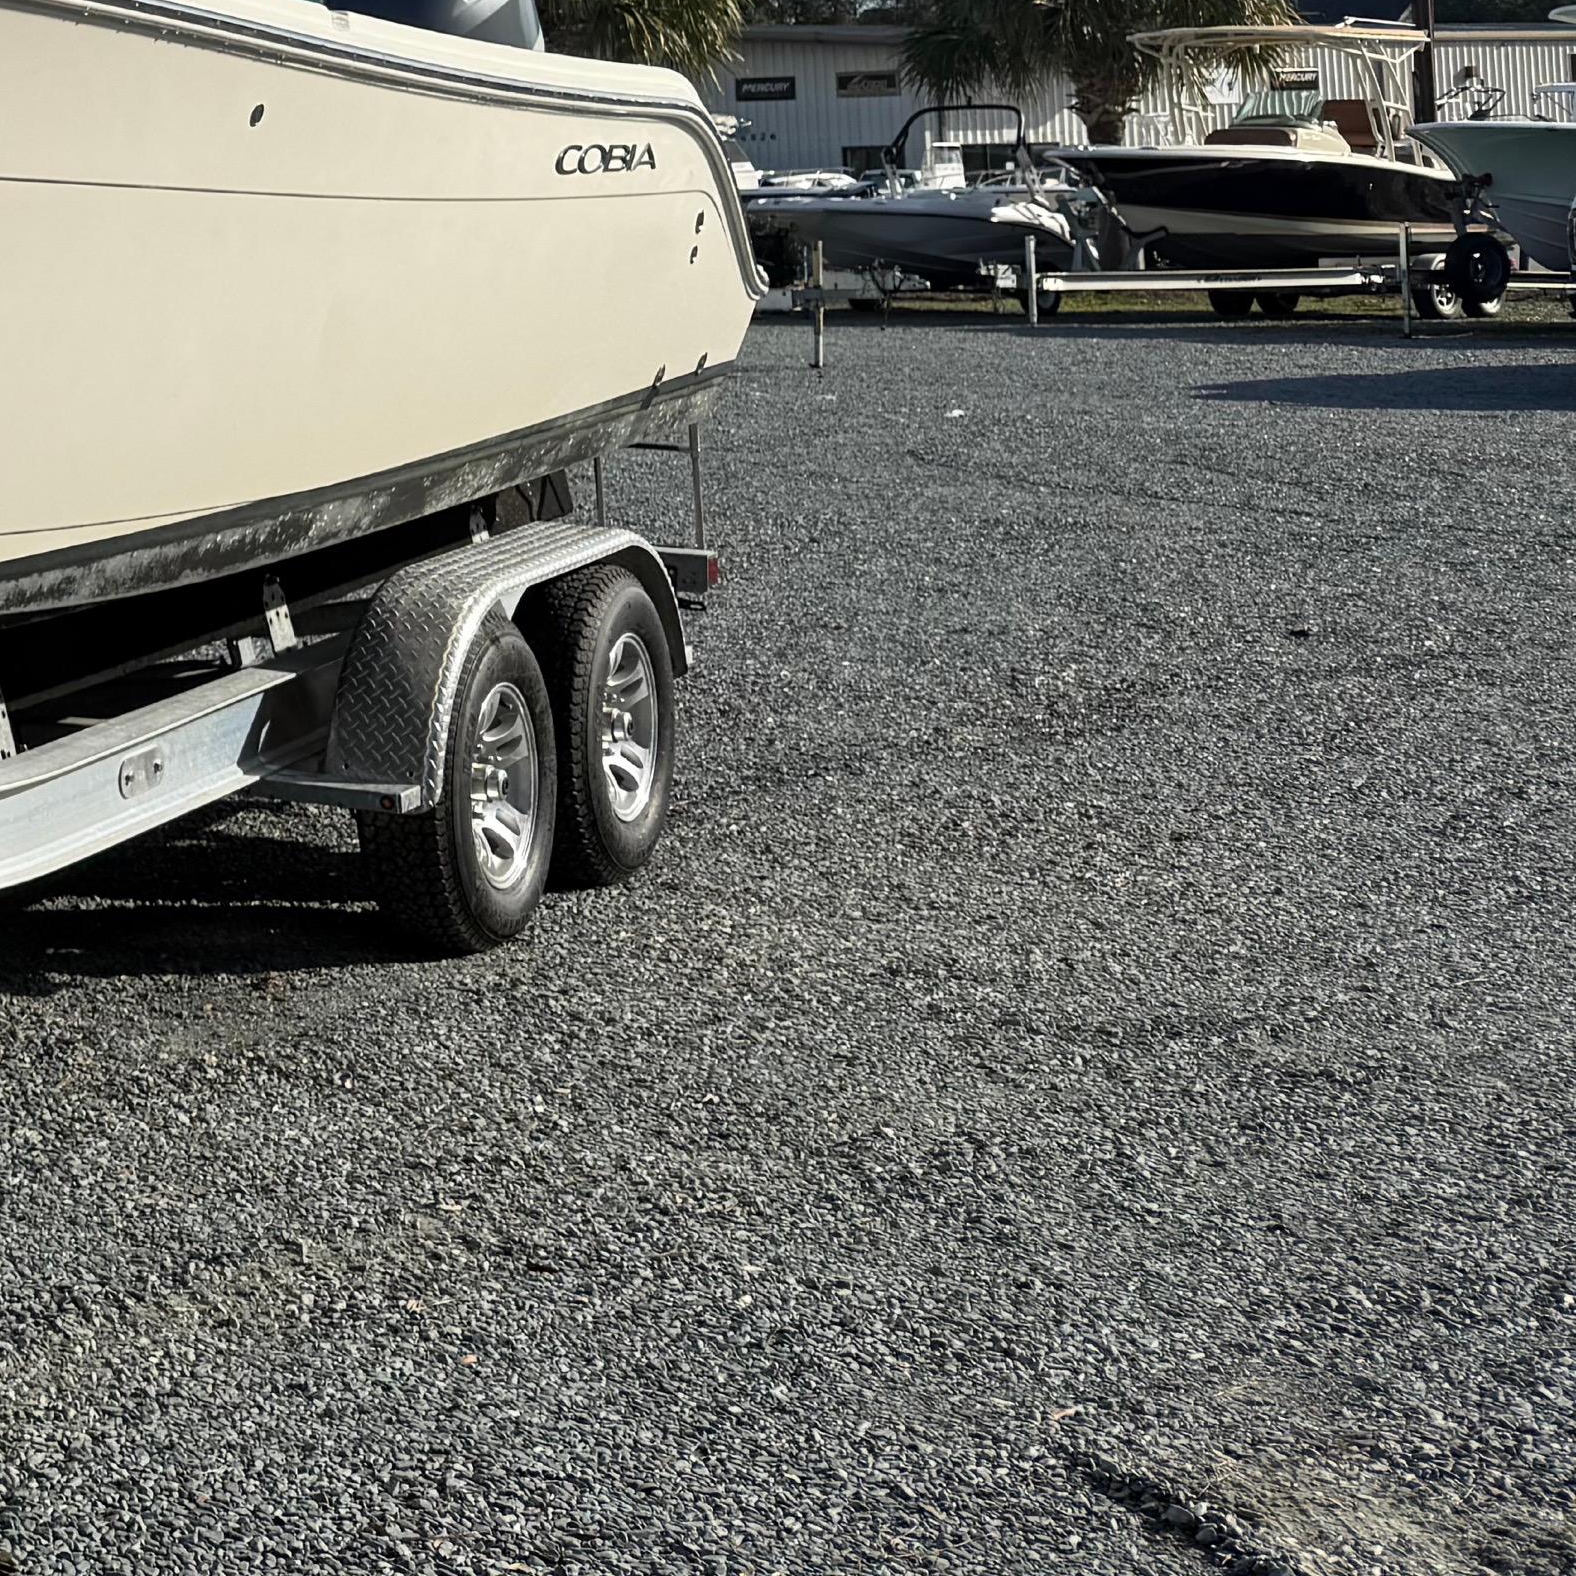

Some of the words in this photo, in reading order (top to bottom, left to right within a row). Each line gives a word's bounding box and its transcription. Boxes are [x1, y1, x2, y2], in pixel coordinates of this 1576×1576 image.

[1279, 72, 1318, 82] MERCURY
[742, 81, 790, 92] MERCURY
[555, 142, 656, 175] COBIA
